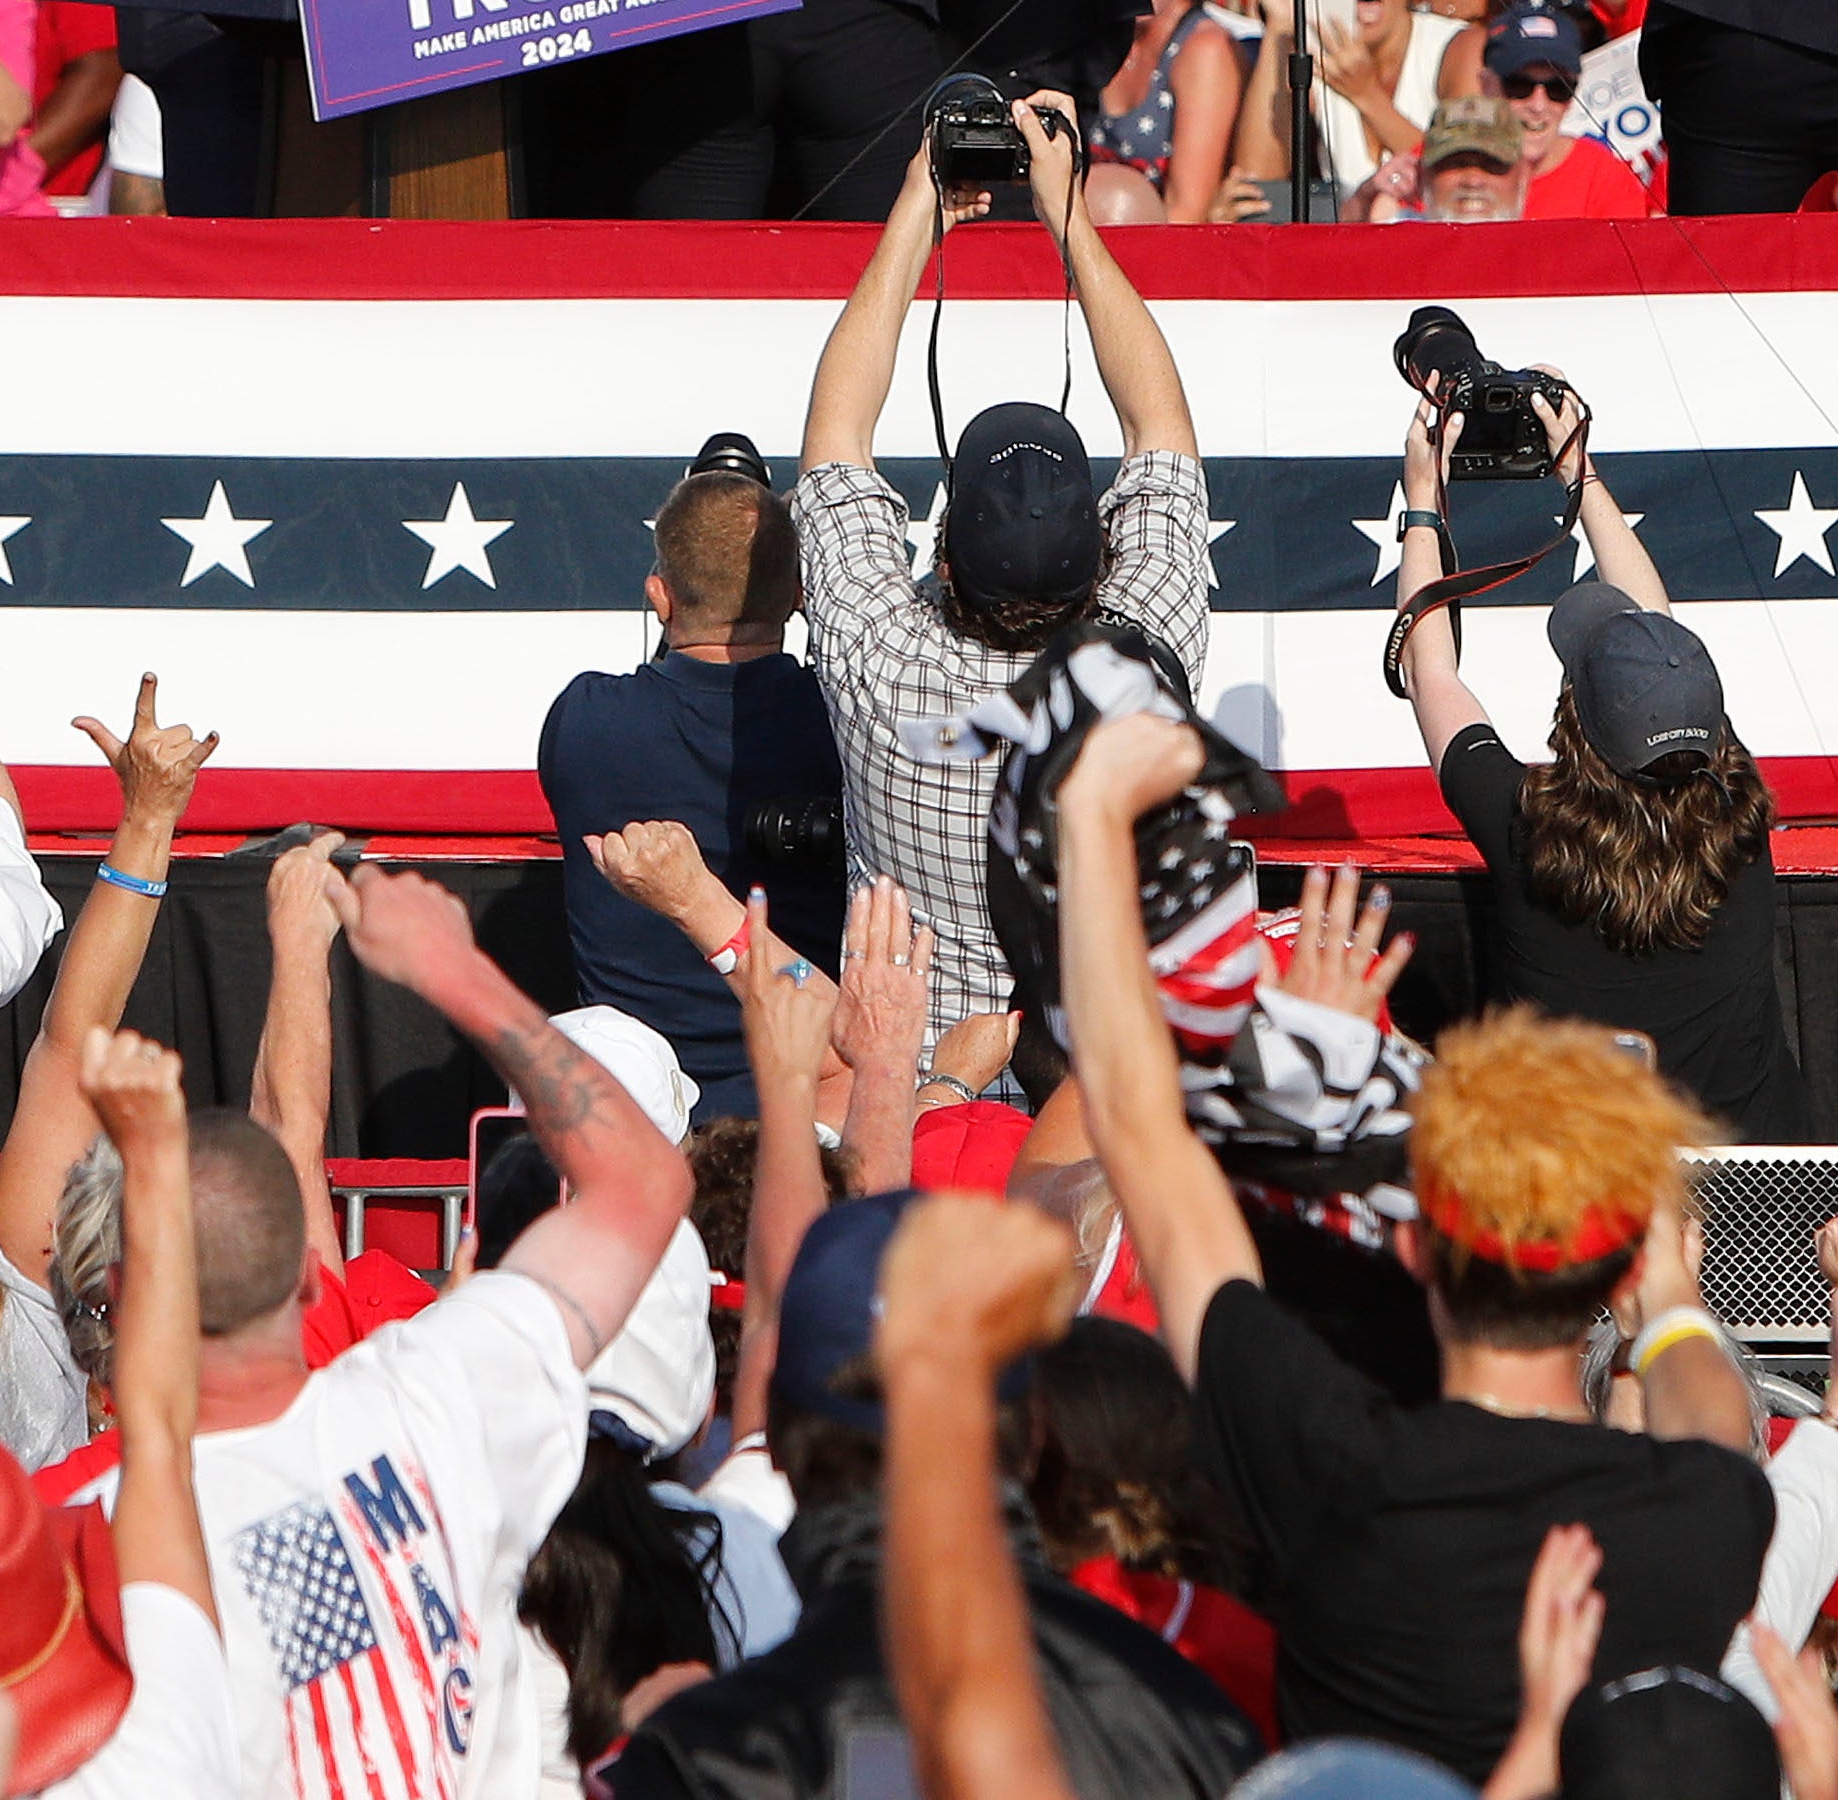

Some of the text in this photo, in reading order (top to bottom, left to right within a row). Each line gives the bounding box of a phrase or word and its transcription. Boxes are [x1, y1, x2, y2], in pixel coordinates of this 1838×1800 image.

[413, 31, 468, 60] MAKE
[470, 11, 556, 47] AMERICA
[520, 28, 593, 66] 2024
[1386, 612, 1414, 672] Canon
